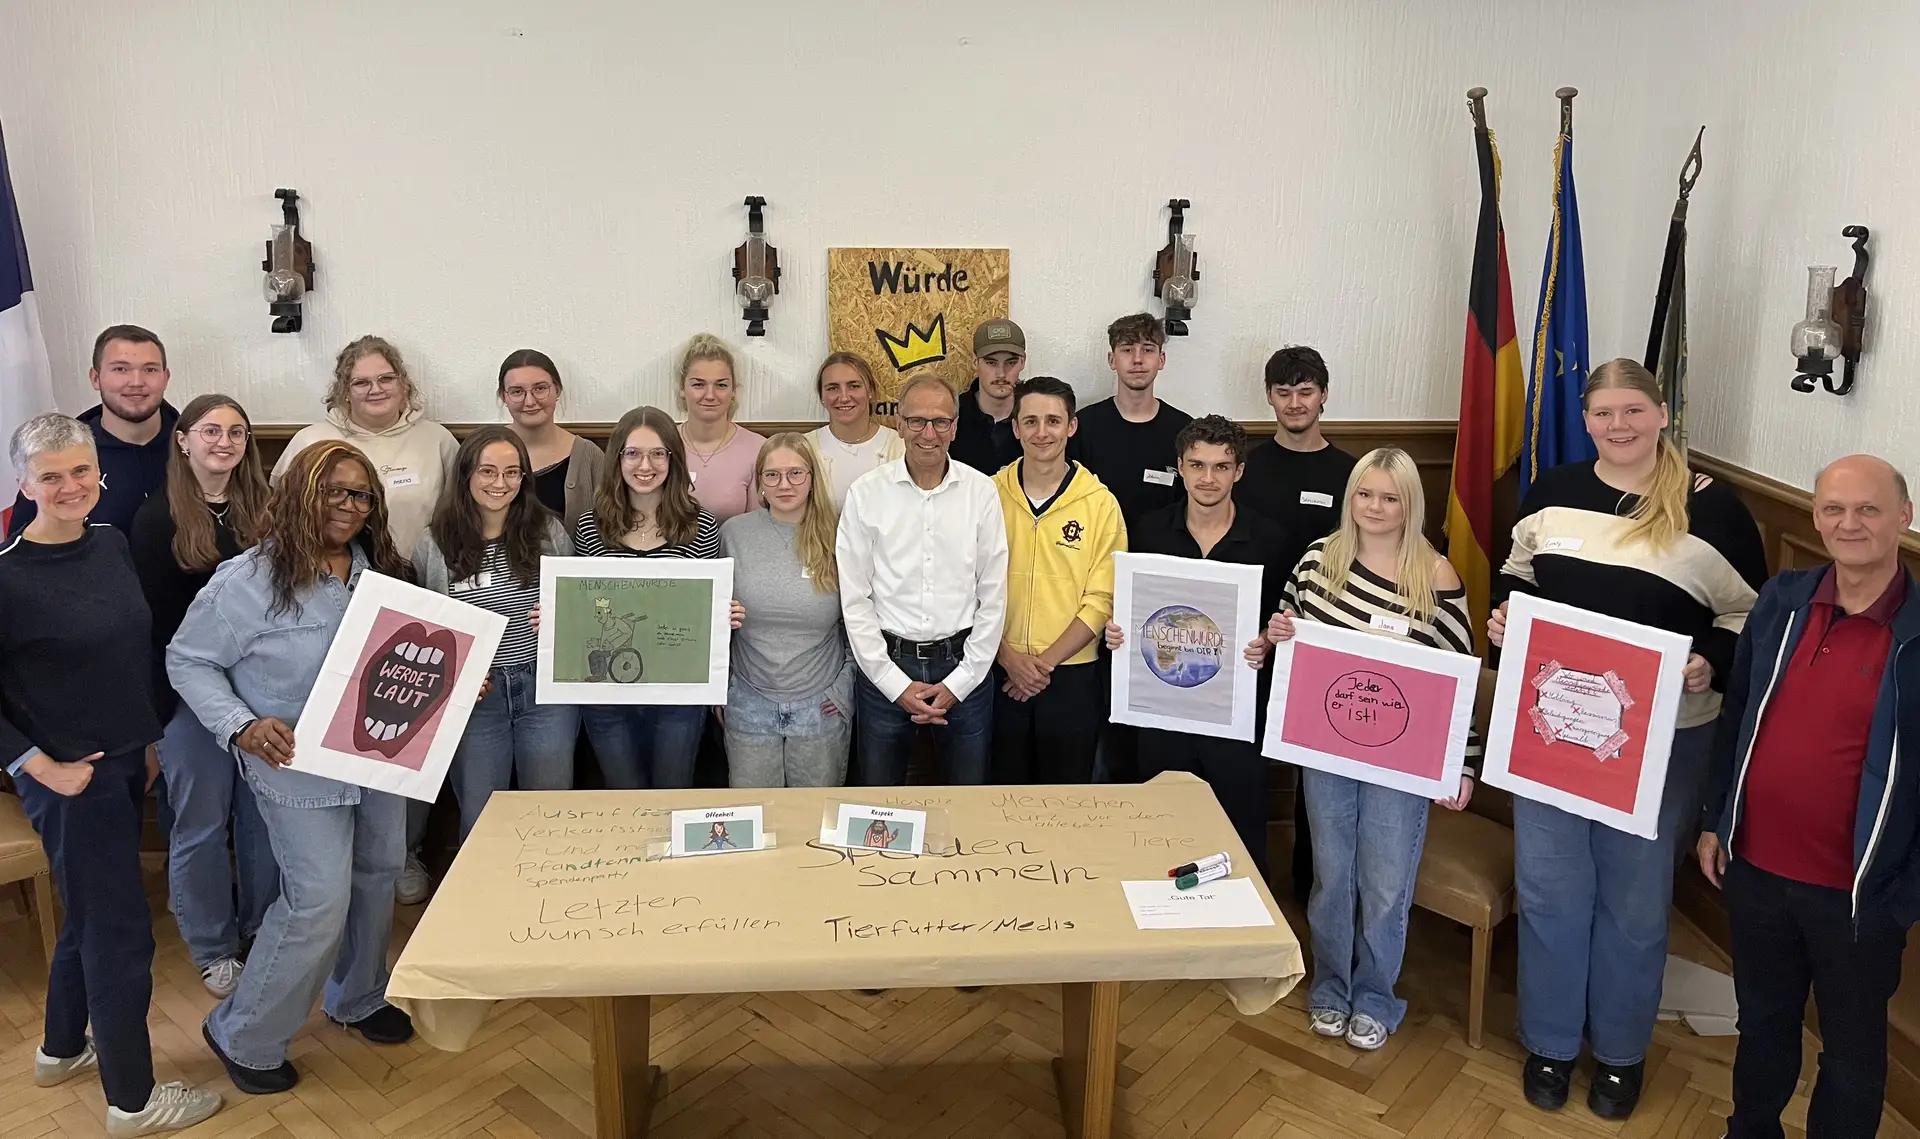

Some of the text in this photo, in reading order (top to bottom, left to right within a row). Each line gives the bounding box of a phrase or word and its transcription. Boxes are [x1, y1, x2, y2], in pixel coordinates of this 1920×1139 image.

[868, 261, 970, 295] Würde
[1378, 617, 1395, 630] Jana
[379, 660, 440, 689] WERDET
[1348, 677, 1384, 693] Jeder
[373, 681, 430, 708] LAUT
[1335, 689, 1406, 709] darf sein wie
[1331, 701, 1377, 725] er ist!
[886, 796, 952, 807] Hospiz
[992, 792, 1135, 809] Menschen
[705, 811, 735, 819] Offenheit
[870, 809, 894, 817] Respekt
[1002, 808, 1174, 824] kurz vor dem
[1127, 830, 1198, 848] Tiere
[538, 894, 701, 924] Letzten
[662, 917, 782, 935] erfüllen
